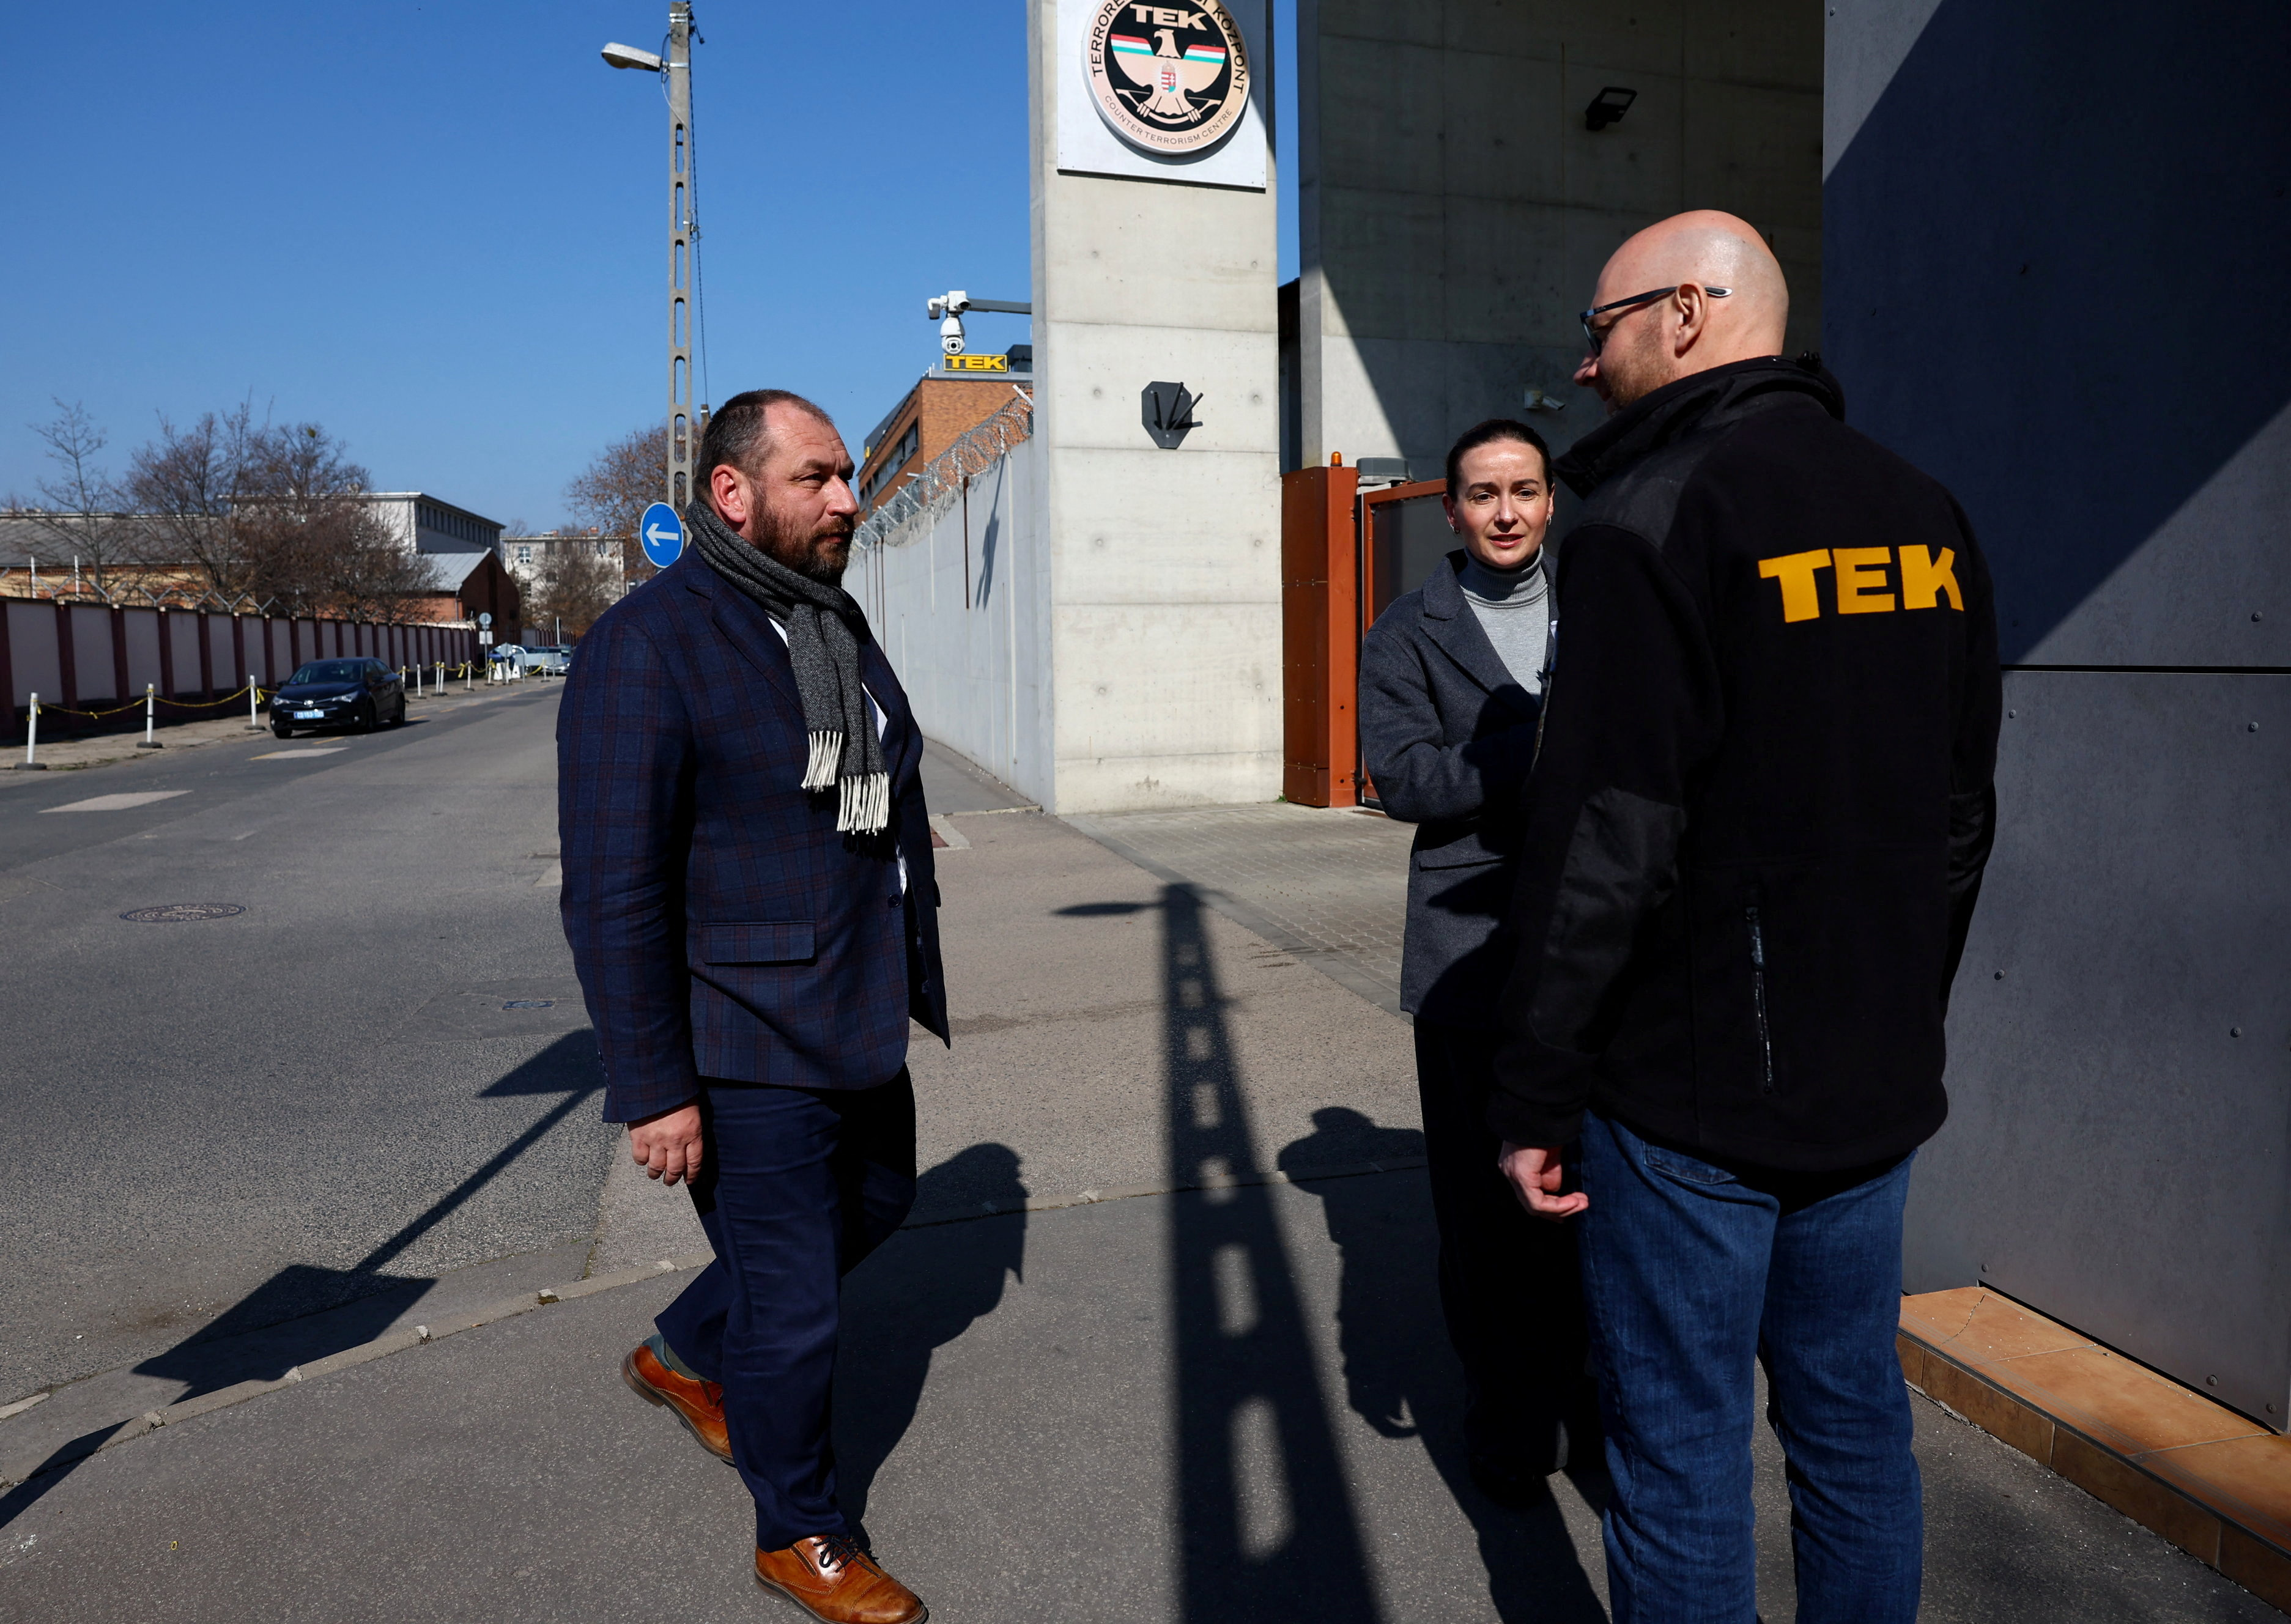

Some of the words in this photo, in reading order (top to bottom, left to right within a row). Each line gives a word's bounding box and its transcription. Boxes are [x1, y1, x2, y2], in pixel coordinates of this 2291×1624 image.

[1130, 3, 1208, 31] TEK
[1213, 6, 1245, 94] KÖZPONT
[1105, 95, 1143, 135] COUNTER
[1145, 131, 1201, 144] TERRORISM
[1202, 109, 1232, 137] CENTRE
[946, 355, 1005, 369] TEK
[1758, 544, 1964, 623] TEK
